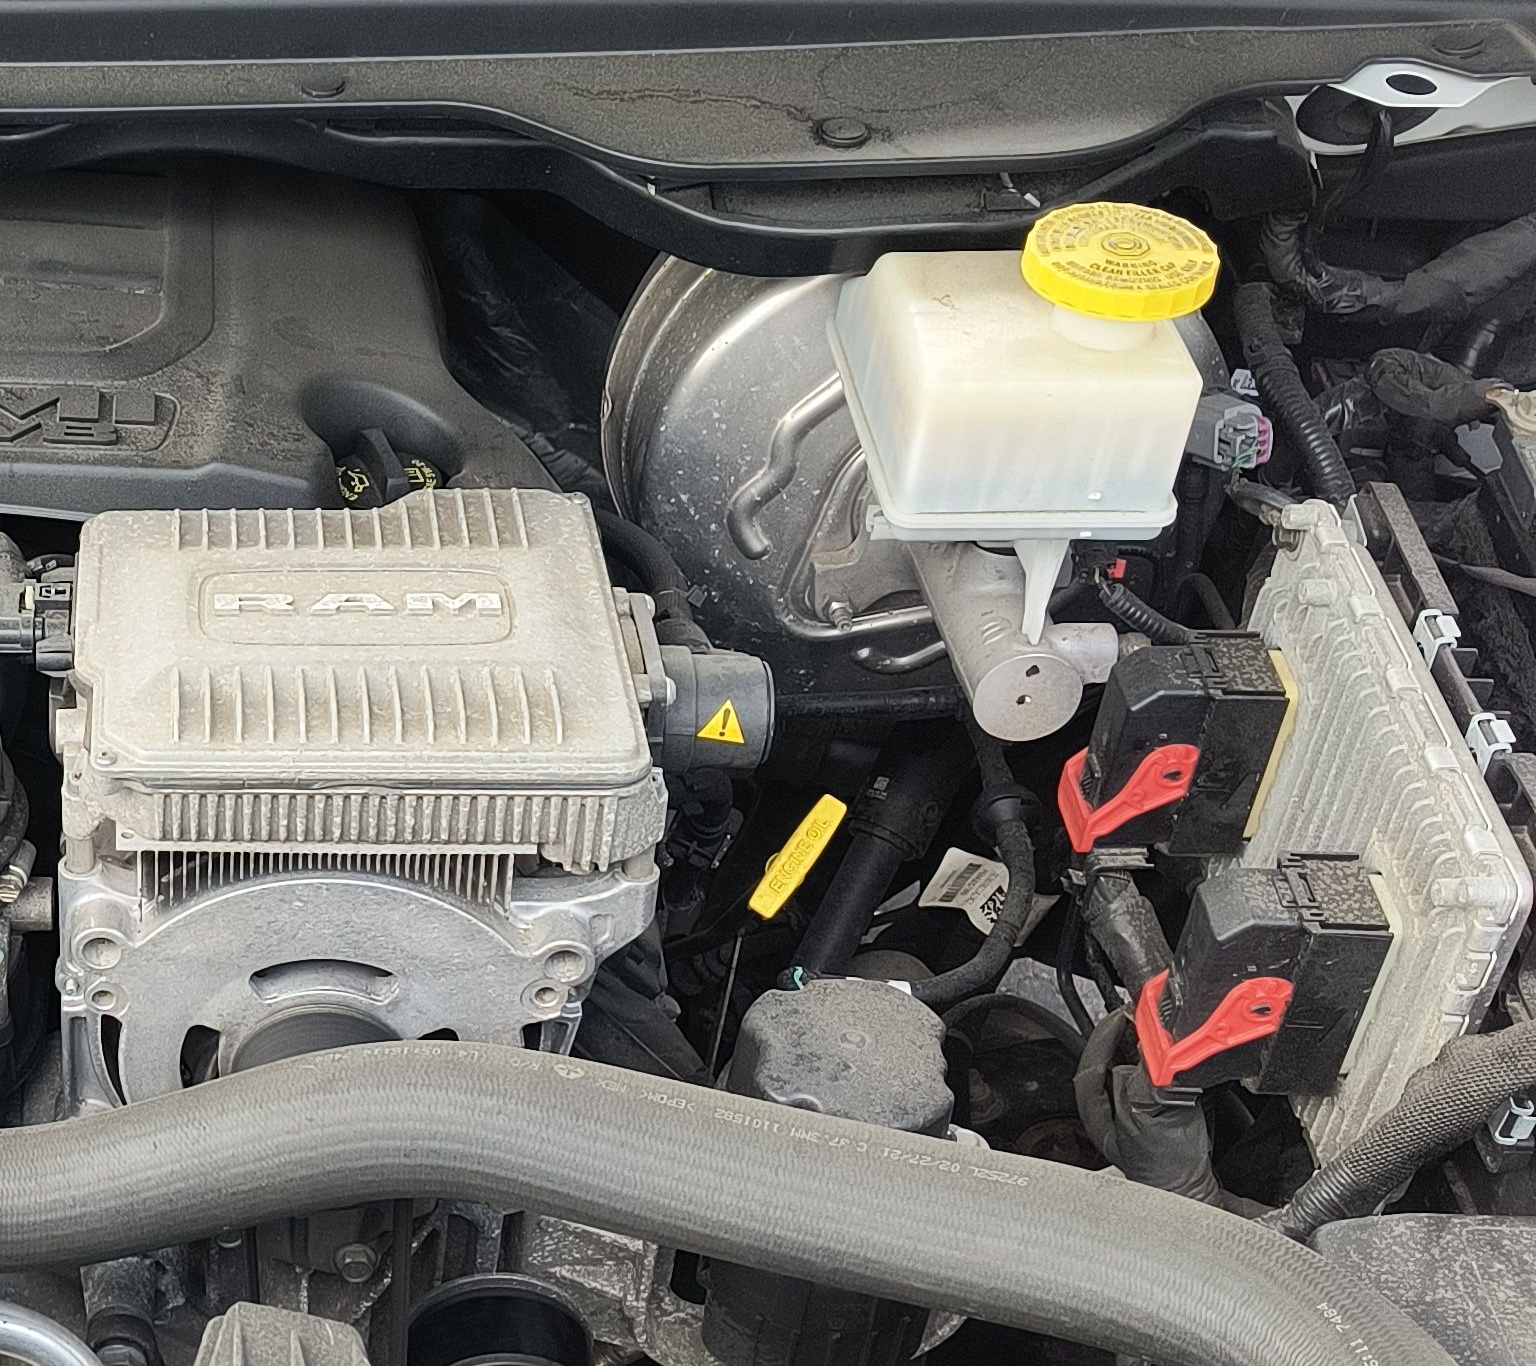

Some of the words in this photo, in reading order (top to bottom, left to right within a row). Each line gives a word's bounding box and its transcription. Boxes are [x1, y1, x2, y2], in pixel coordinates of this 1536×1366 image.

[213, 592, 503, 617] RAM
[769, 838, 814, 894] ENGINE
[806, 819, 834, 841] OIL
[883, 1147, 961, 1173] 02/27/21
[1315, 1302, 1351, 1334] 7484
